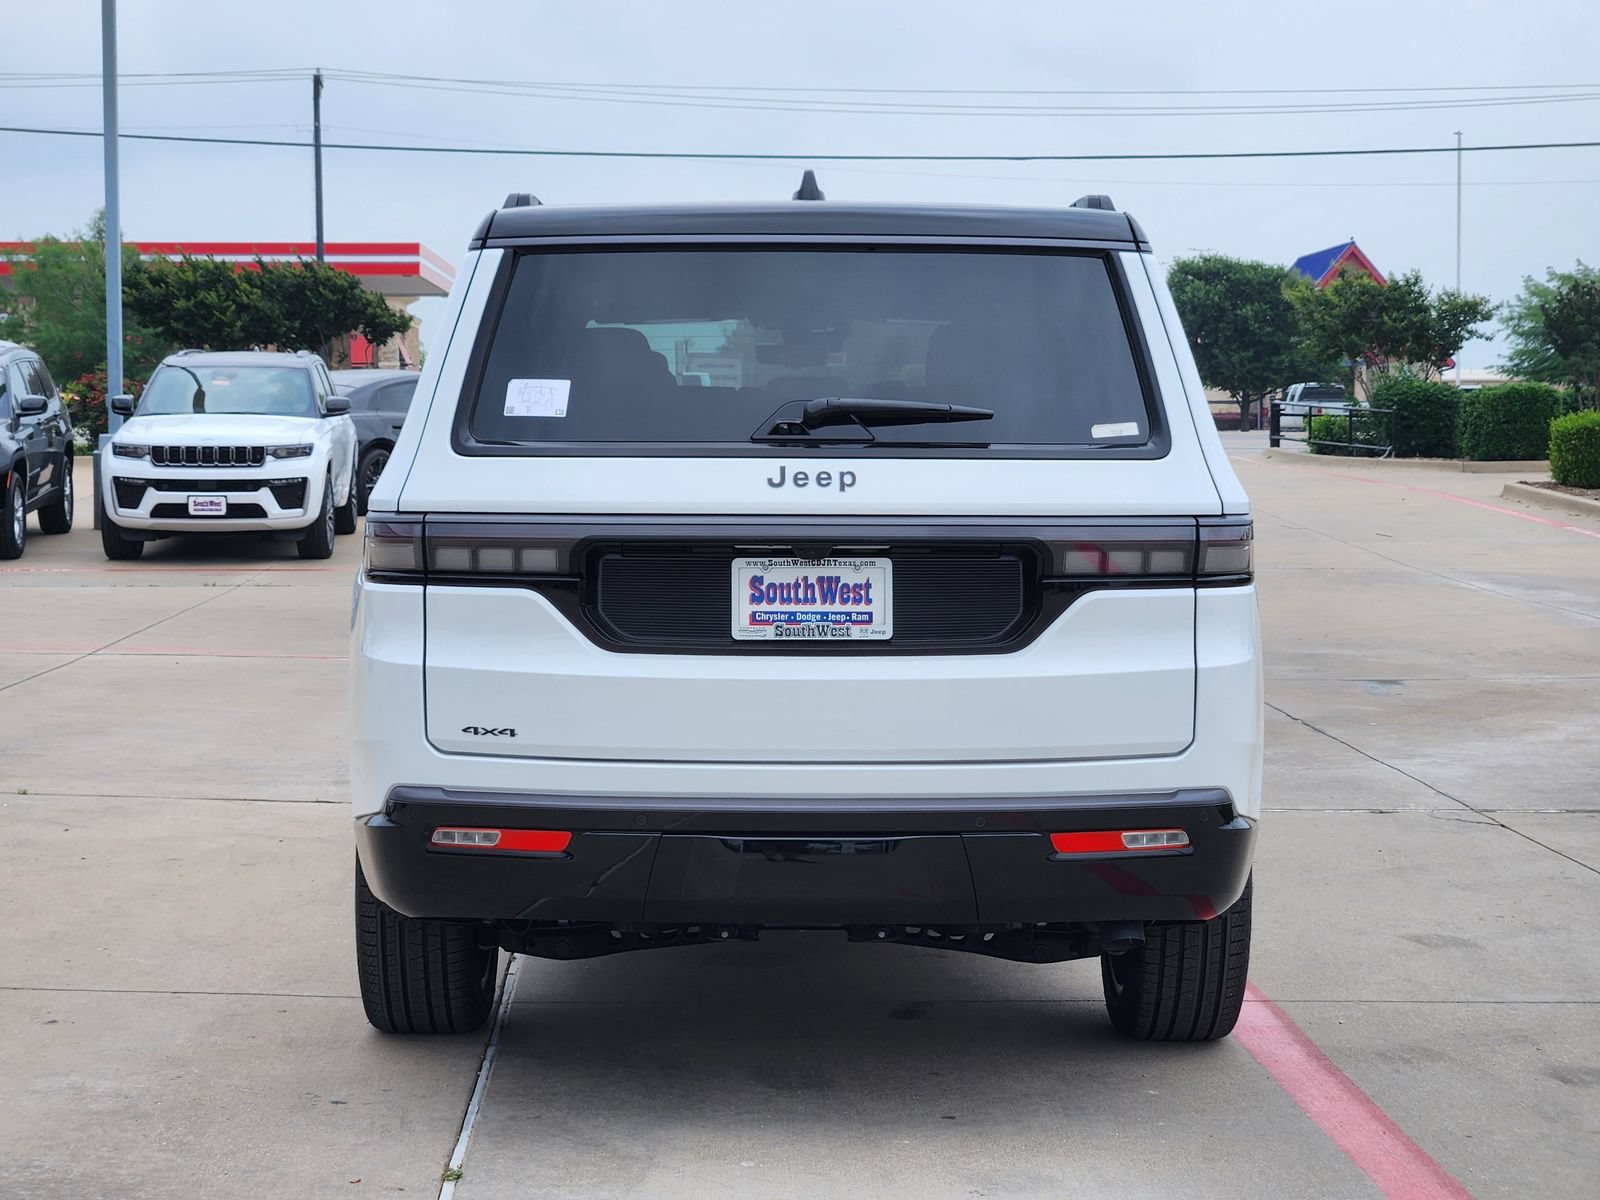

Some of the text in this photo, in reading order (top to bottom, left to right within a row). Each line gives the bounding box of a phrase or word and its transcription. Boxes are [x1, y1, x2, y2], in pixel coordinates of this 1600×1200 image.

[767, 465, 856, 492] Jeep
[745, 559, 876, 567] www.SouthWestCDJRTexas.com
[749, 575, 872, 606] SouthWest
[756, 612, 869, 622] Chrysler Dodge Jeep Ram
[775, 625, 851, 637] SouthWest
